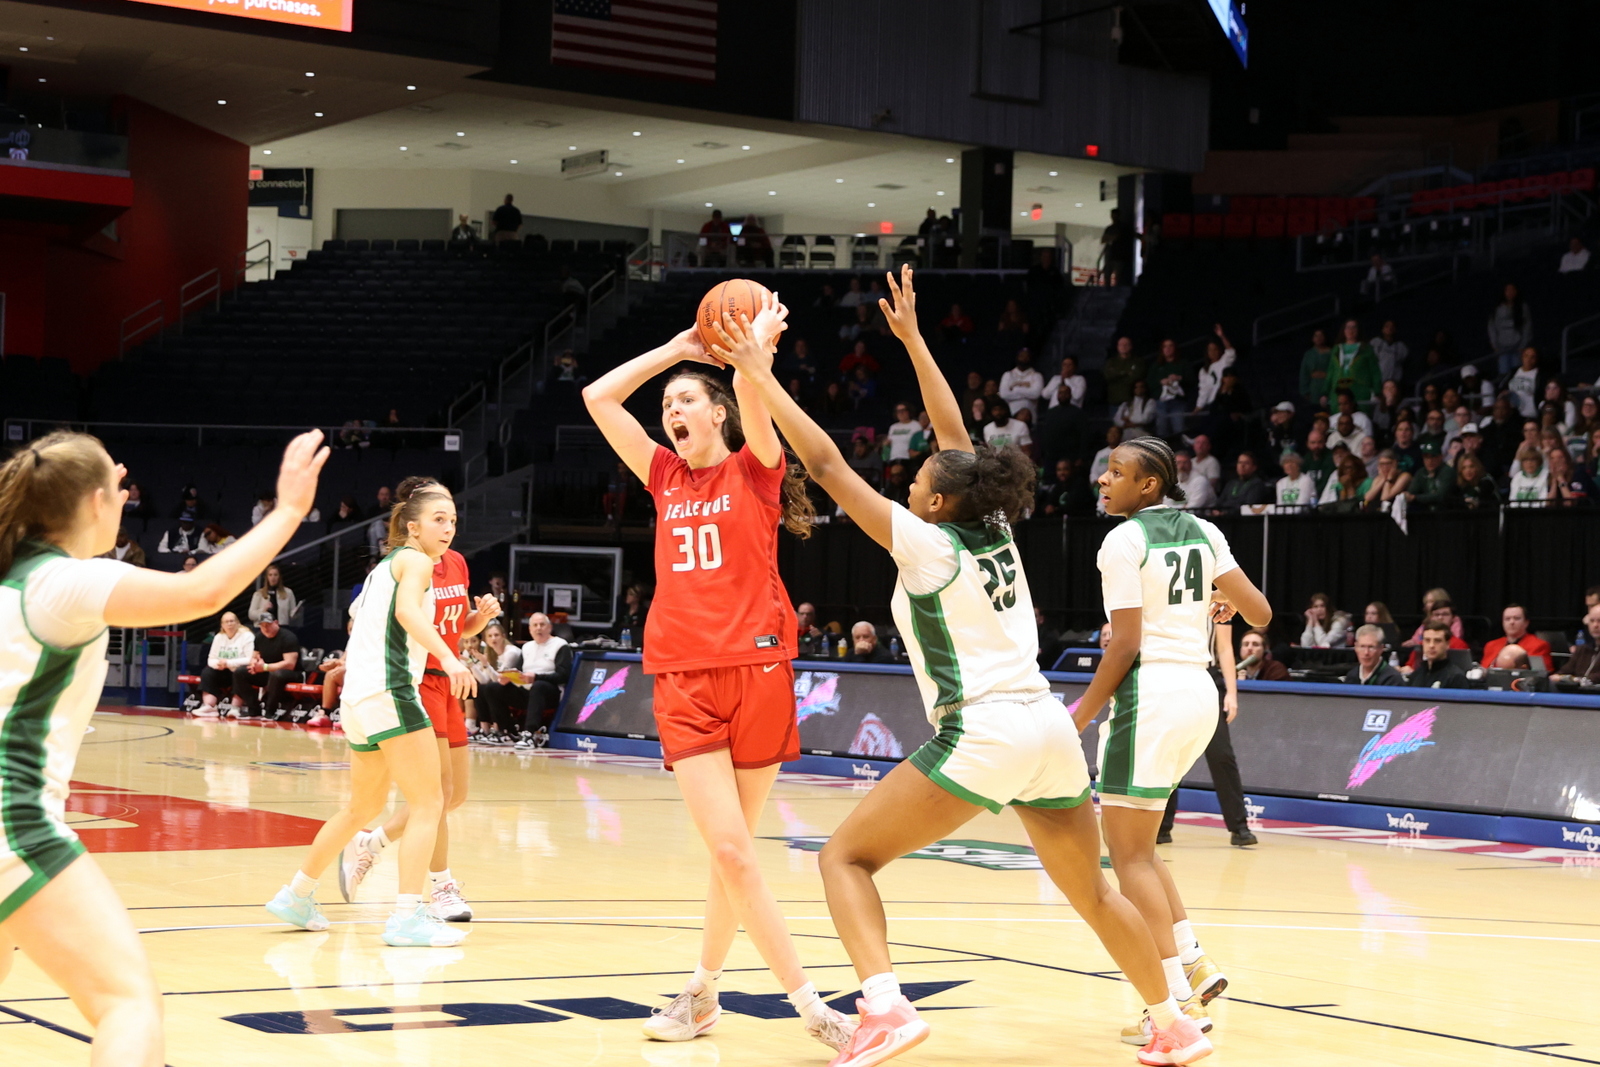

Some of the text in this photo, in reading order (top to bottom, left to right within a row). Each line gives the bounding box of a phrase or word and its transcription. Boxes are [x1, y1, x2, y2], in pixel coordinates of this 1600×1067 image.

[244, 0, 321, 17] purchases.
[672, 523, 723, 572] 30
[976, 547, 1017, 612] 25
[1164, 548, 1204, 605] 24
[439, 603, 464, 636] 14
[1399, 812, 1430, 836] Kroger
